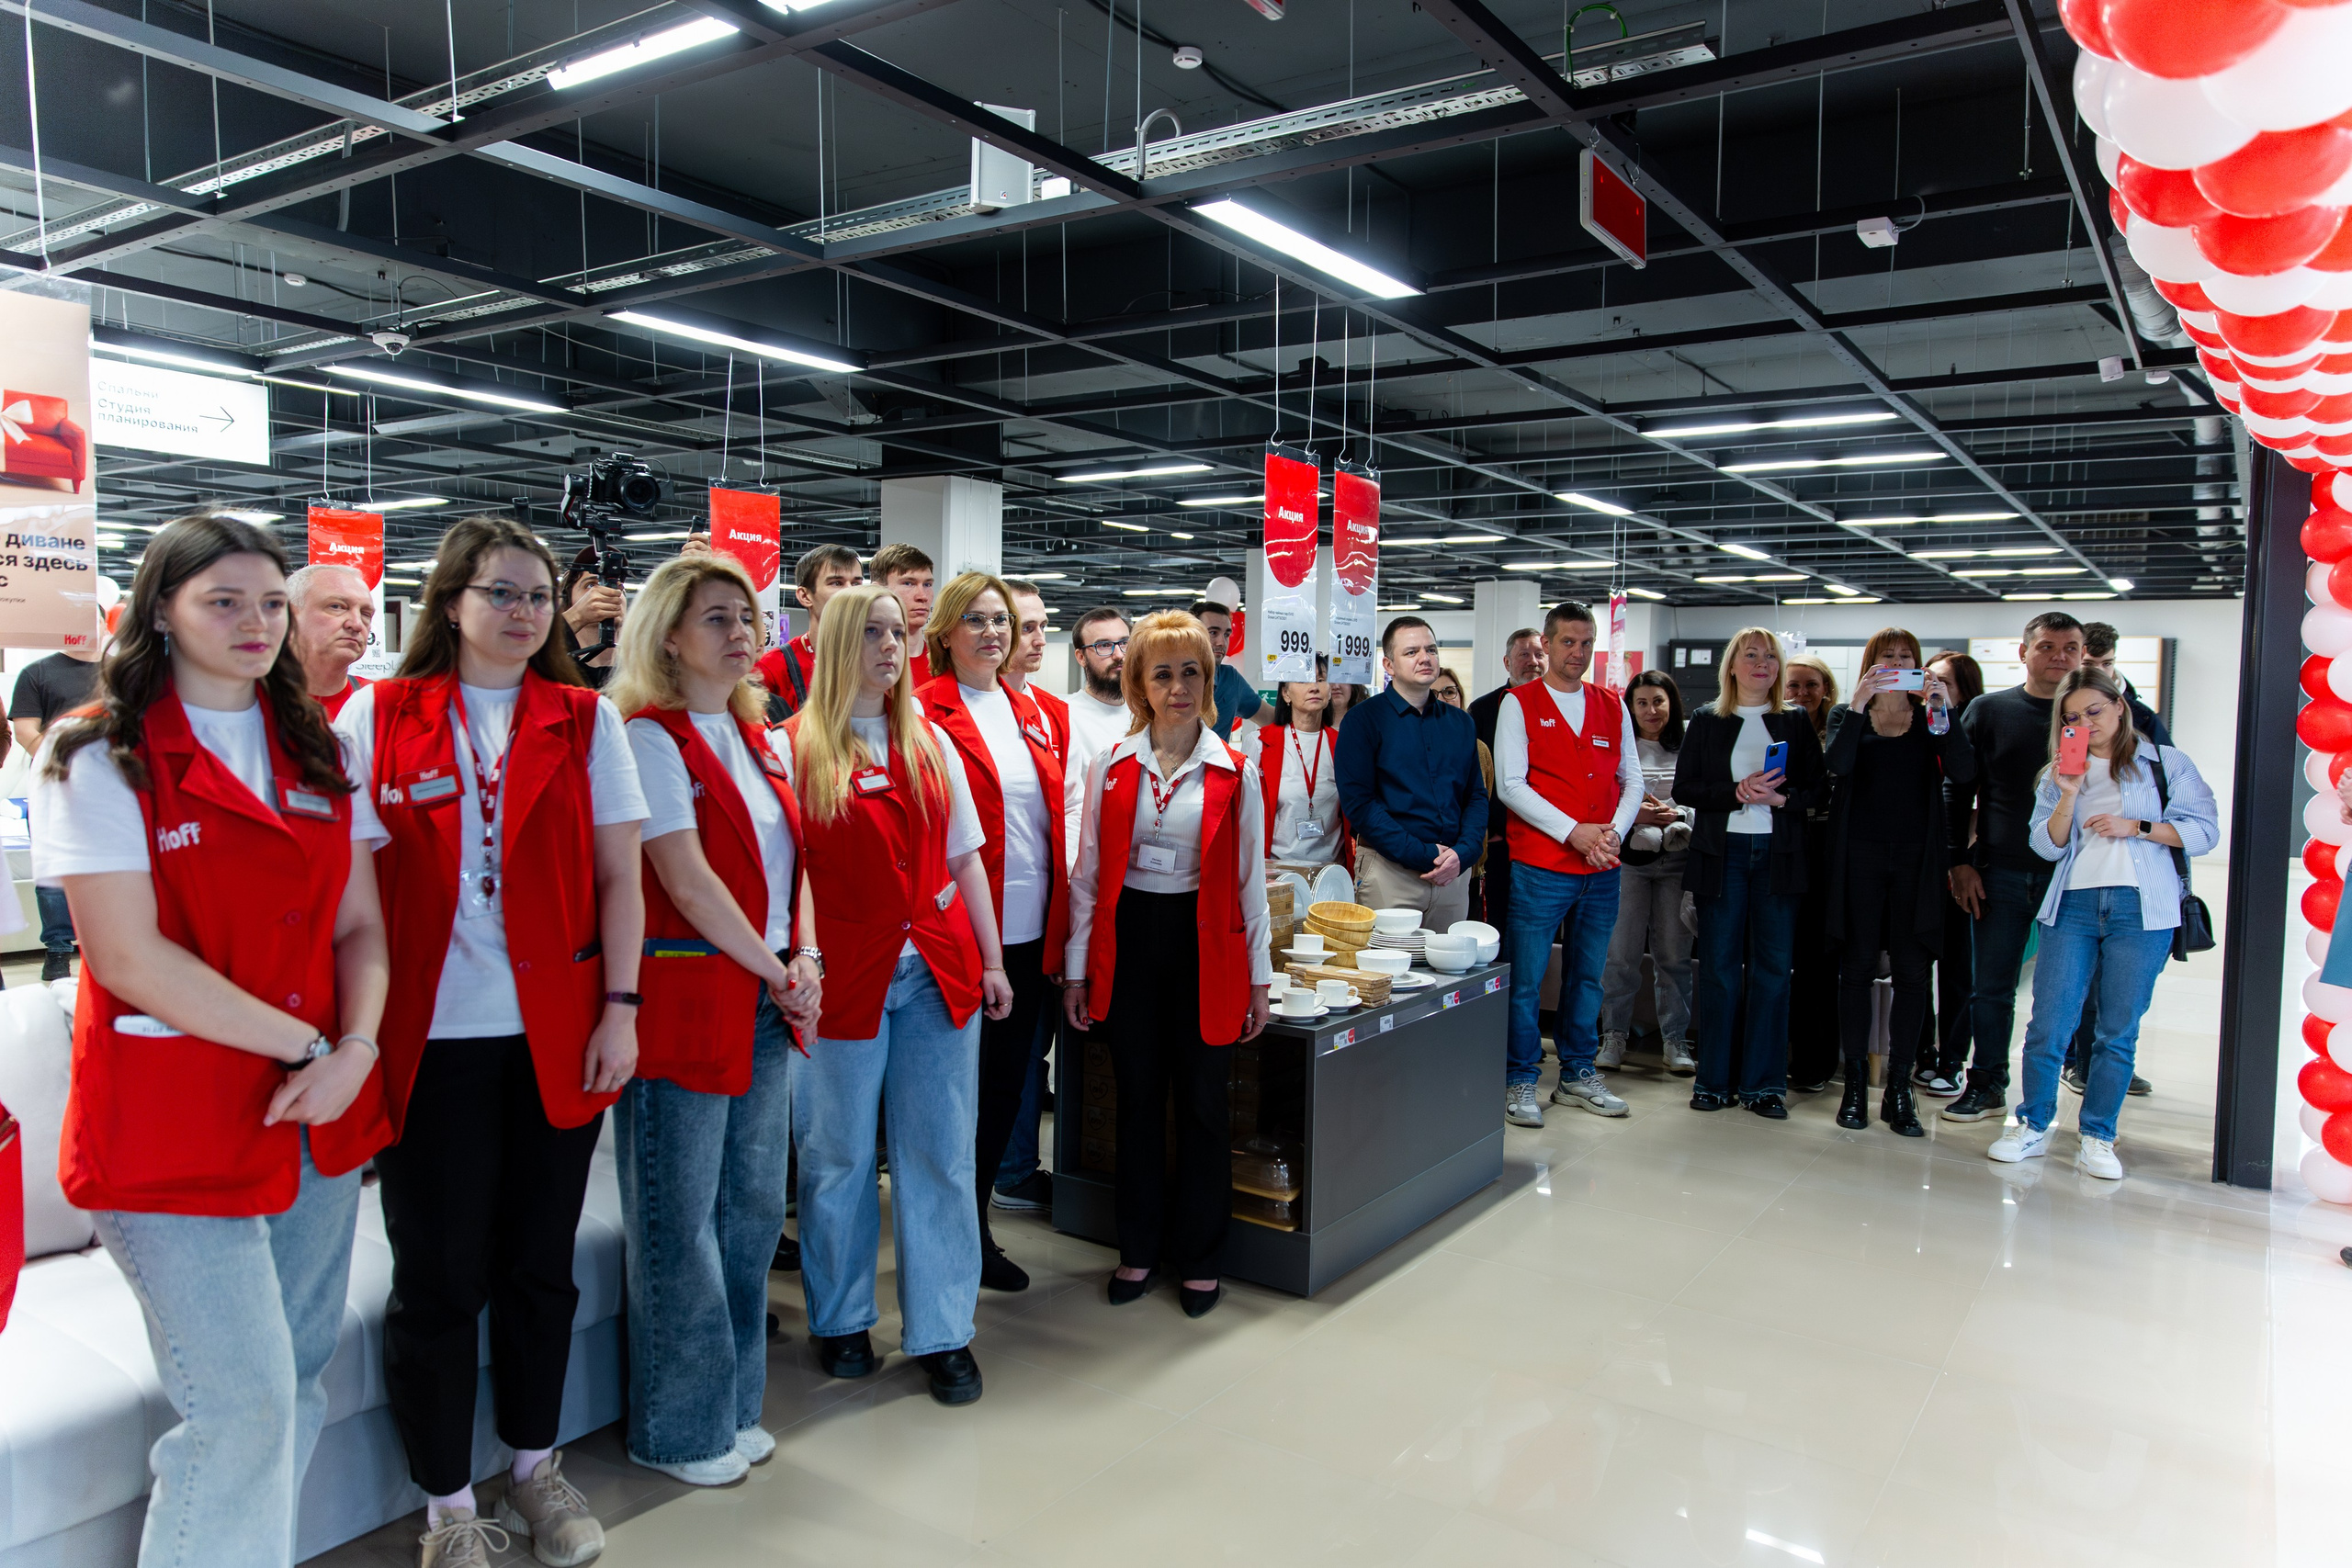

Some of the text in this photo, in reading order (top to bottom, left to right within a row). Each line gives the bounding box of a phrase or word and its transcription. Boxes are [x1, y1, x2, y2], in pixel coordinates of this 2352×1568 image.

[97, 381, 159, 399] Спальни
[97, 398, 151, 414] Студия
[97, 412, 198, 434] планирования
[1278, 505, 1304, 524] Акция
[729, 528, 763, 543] Акция
[1347, 519, 1369, 536] Акция
[6, 533, 85, 550] диване
[329, 542, 365, 555] Акция
[23, 555, 88, 571] здесь
[64, 634, 86, 645] Hoff
[1540, 718, 1555, 727] Hoff
[419, 769, 439, 781] Hoff
[380, 783, 403, 805] Ho
[157, 822, 201, 852] Hoff
